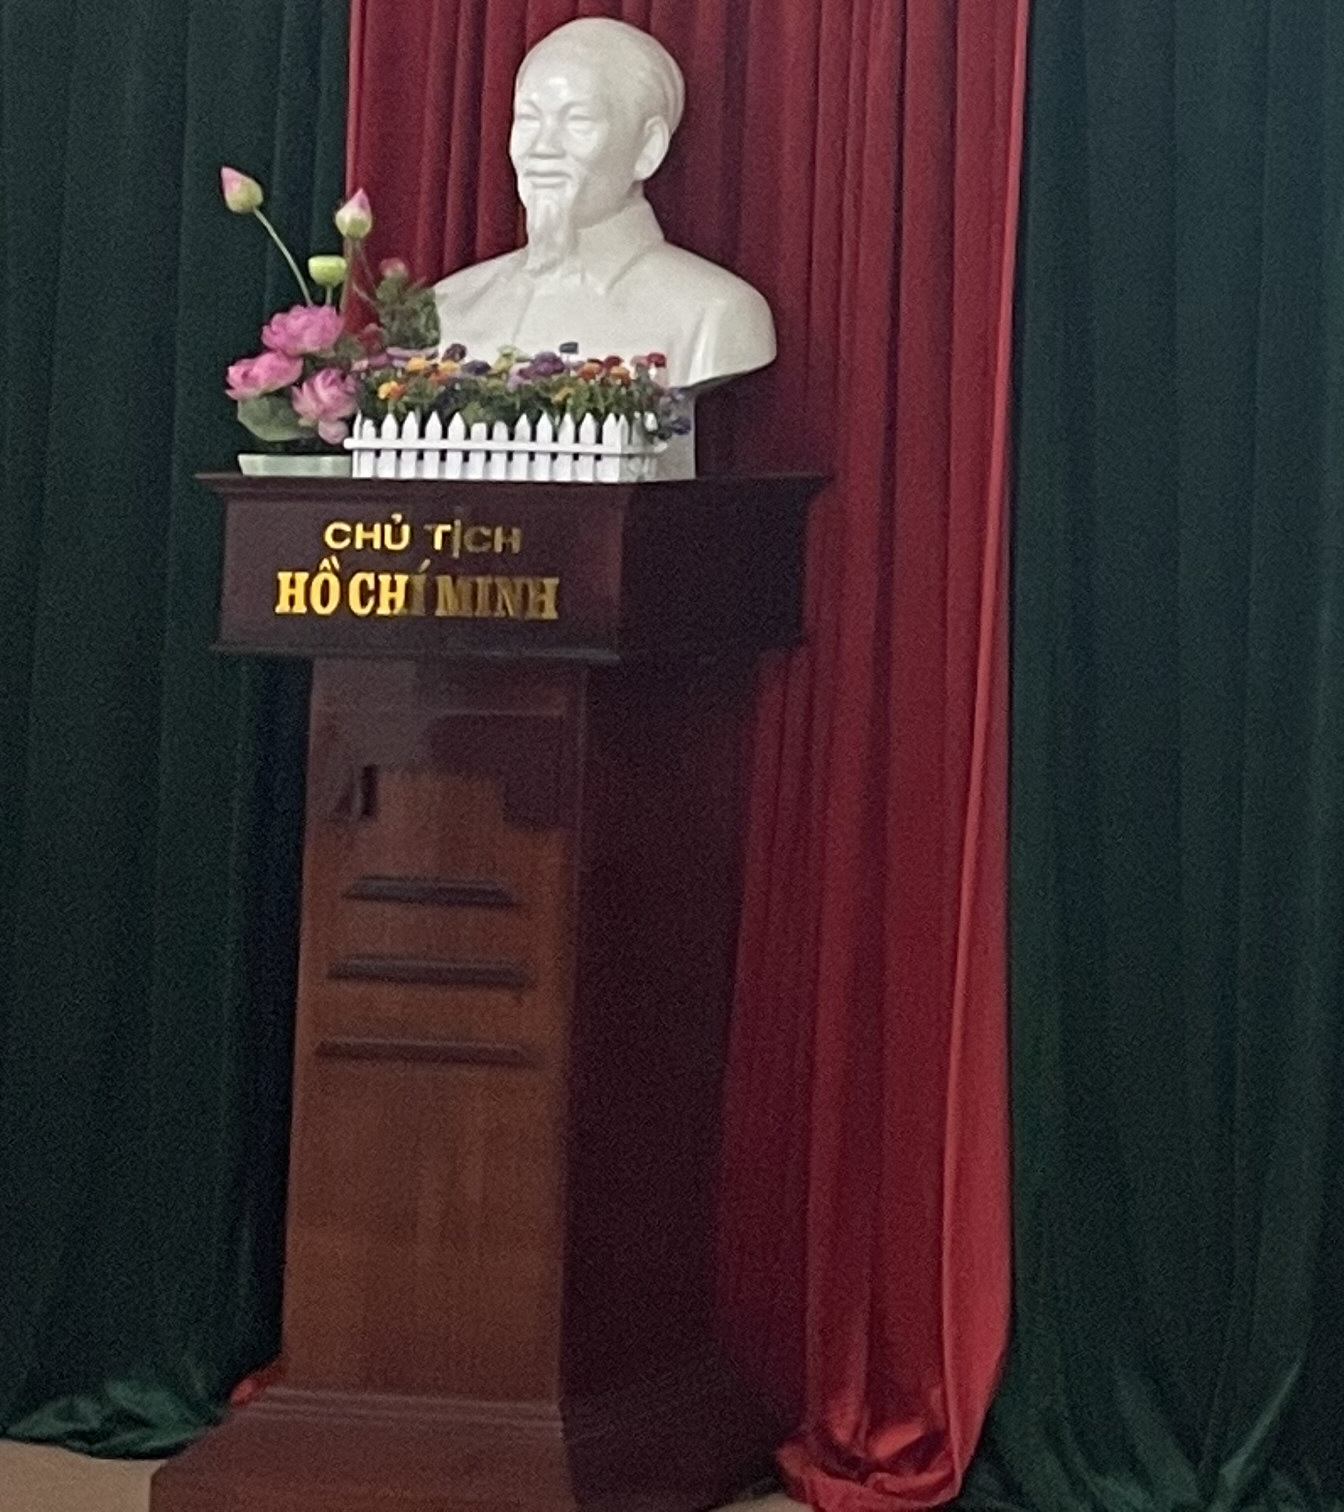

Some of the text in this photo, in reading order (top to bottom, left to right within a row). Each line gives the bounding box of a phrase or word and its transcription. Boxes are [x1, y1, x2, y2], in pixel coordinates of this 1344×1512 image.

[325, 513, 522, 559] CHỦ TỊCH
[275, 555, 559, 620] HỒ CHÍ MINH
